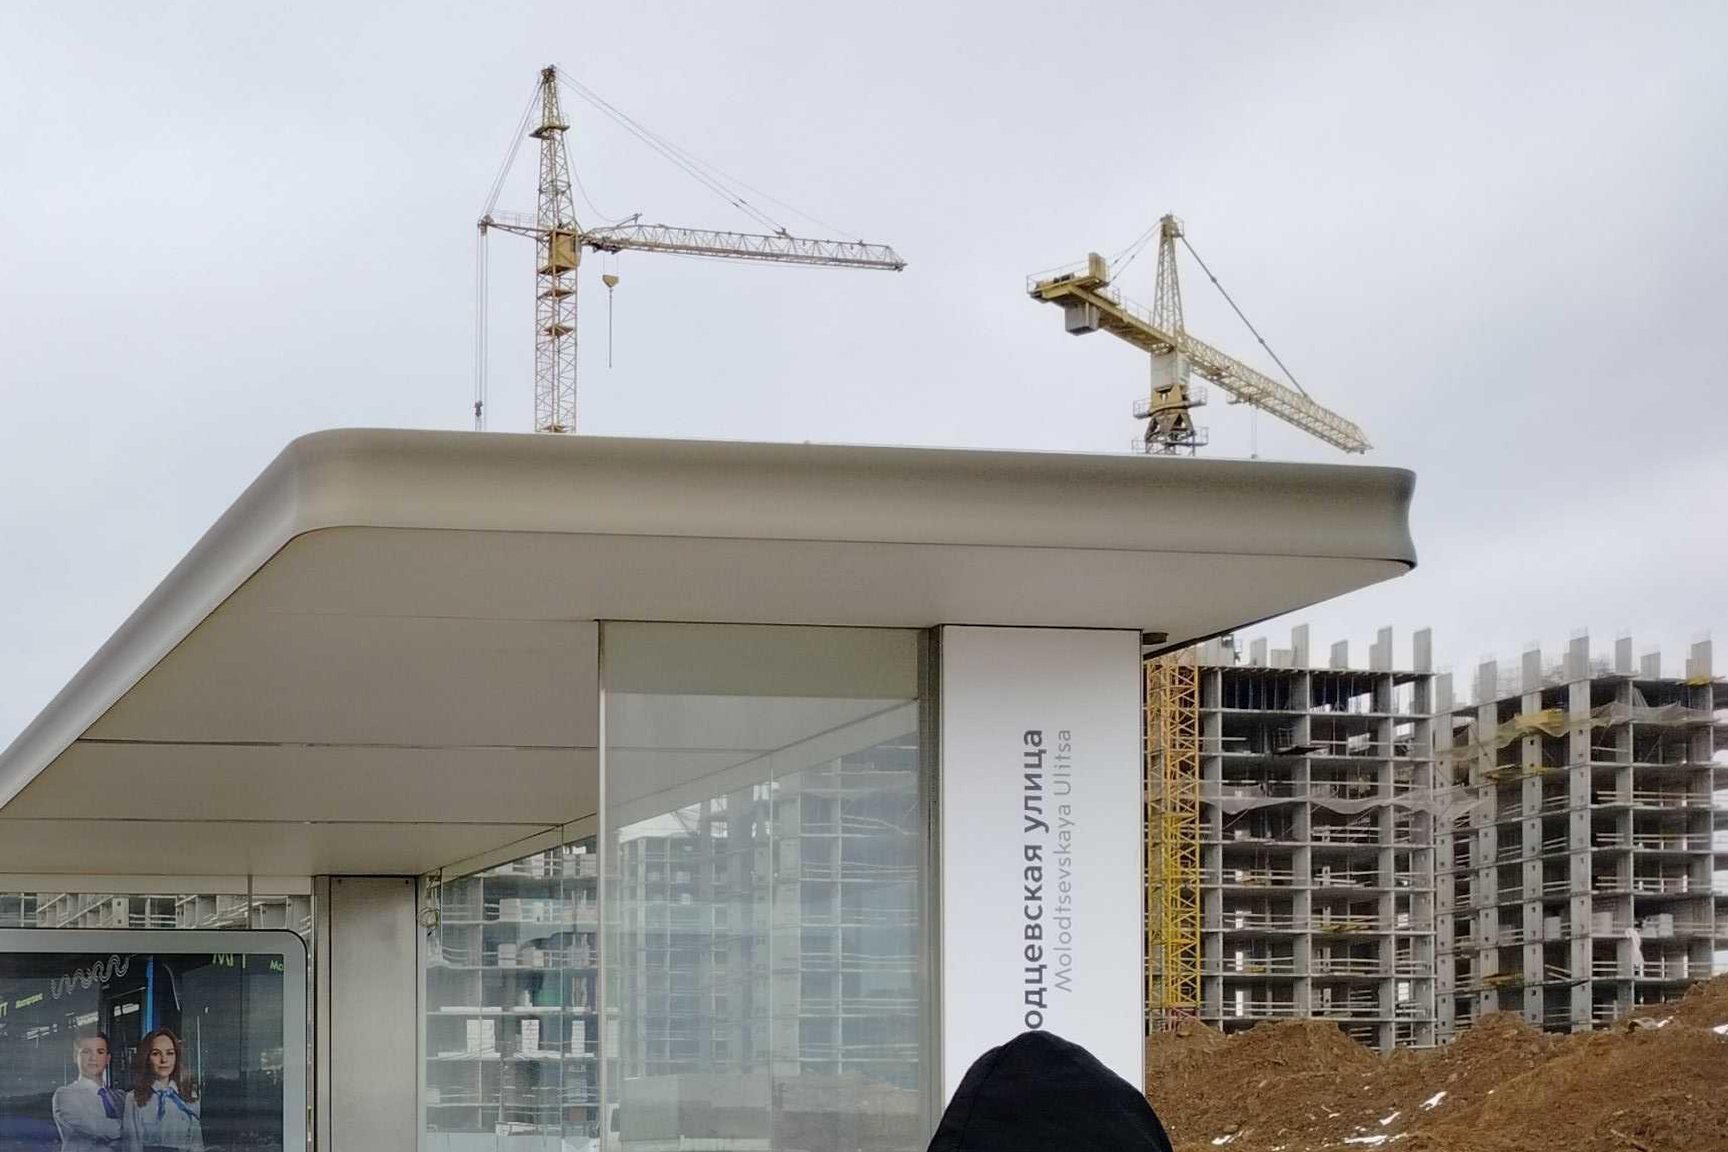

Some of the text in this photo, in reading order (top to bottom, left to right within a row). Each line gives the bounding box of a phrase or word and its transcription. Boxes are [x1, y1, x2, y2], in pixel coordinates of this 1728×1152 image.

[1023, 729, 1049, 1030] одцевская улица
[1053, 729, 1075, 992] Molodtsevskaya Ulitsa
